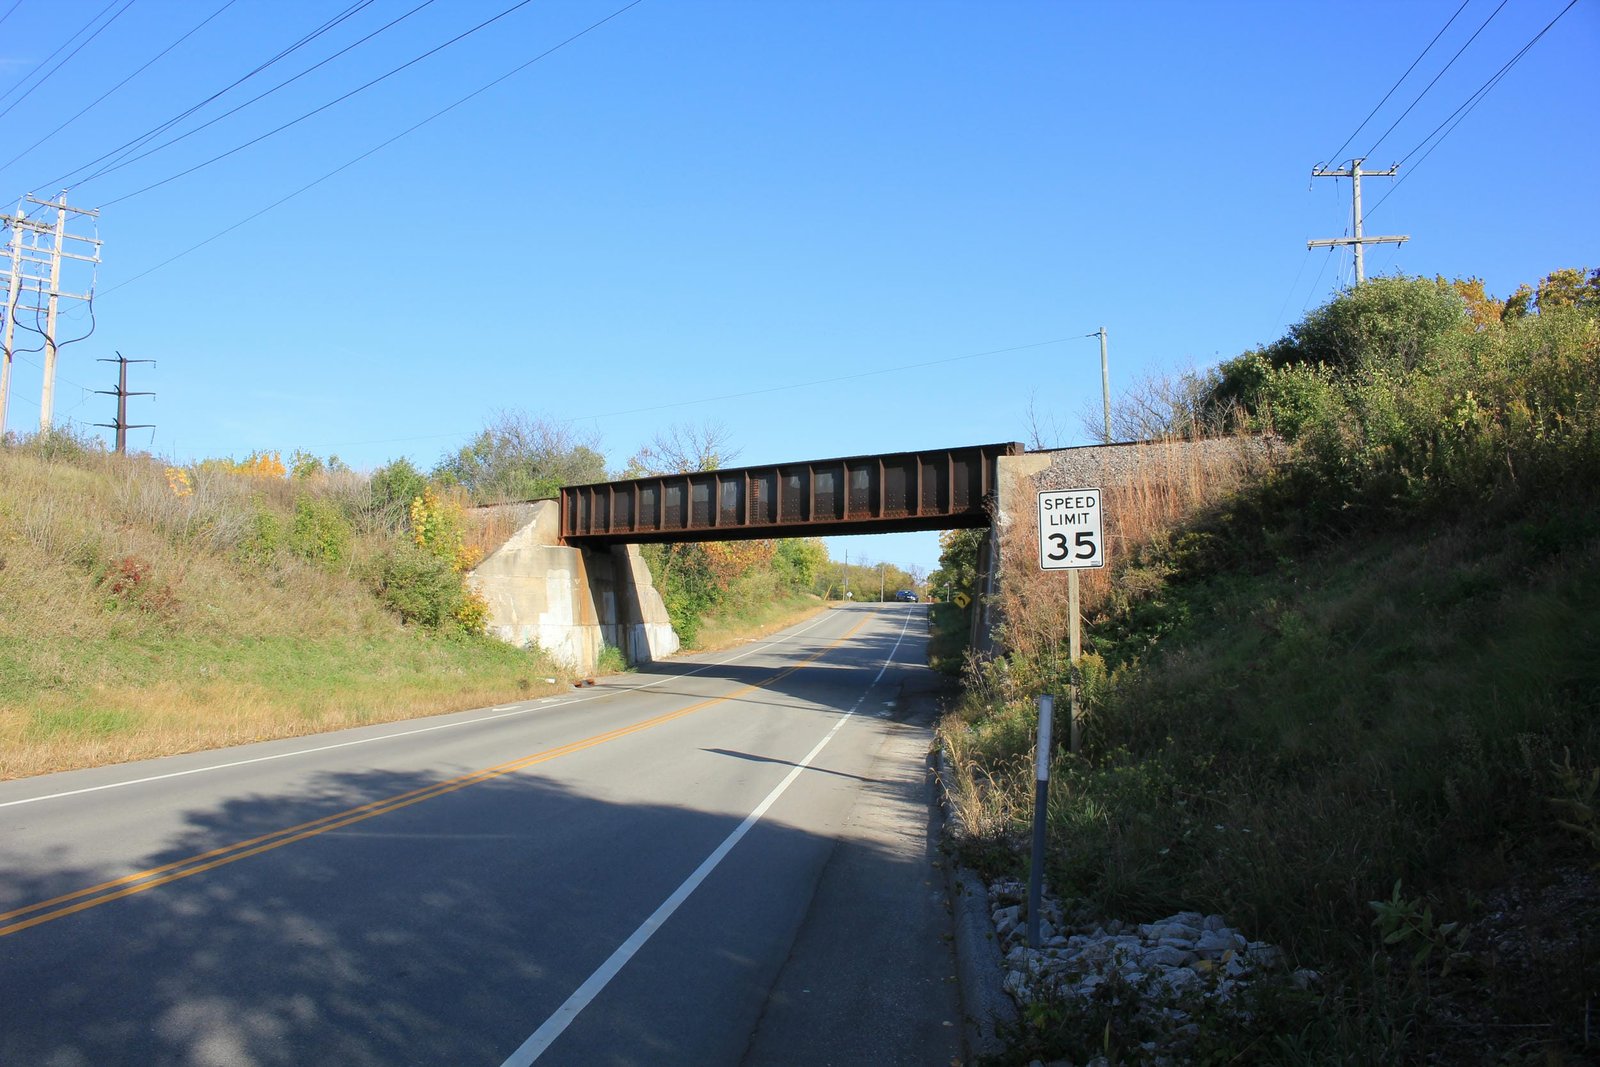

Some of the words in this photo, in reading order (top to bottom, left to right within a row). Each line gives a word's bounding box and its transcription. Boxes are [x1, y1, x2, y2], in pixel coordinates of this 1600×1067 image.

[1044, 497, 1095, 510] SPEED
[1050, 513, 1090, 526] LIMIT
[1047, 531, 1096, 560] 35
